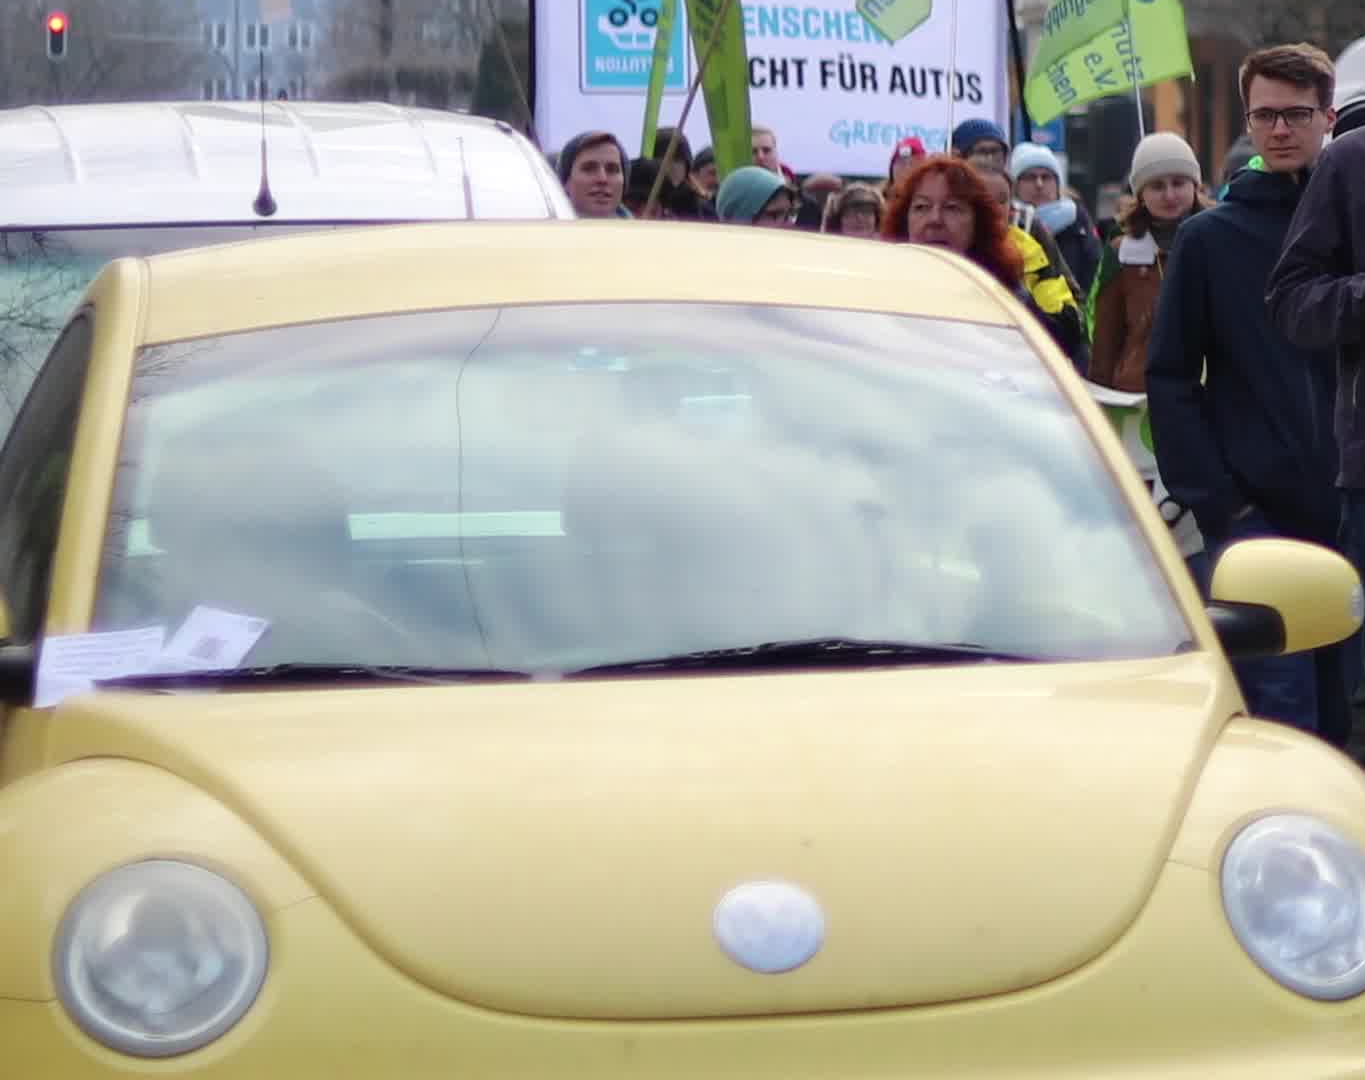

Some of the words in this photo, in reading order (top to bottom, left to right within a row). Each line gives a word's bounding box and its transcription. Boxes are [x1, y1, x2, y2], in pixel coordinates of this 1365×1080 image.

[748, 55, 808, 89] CHT
[819, 53, 878, 93] FÜR
[889, 64, 983, 103] AUTOS
